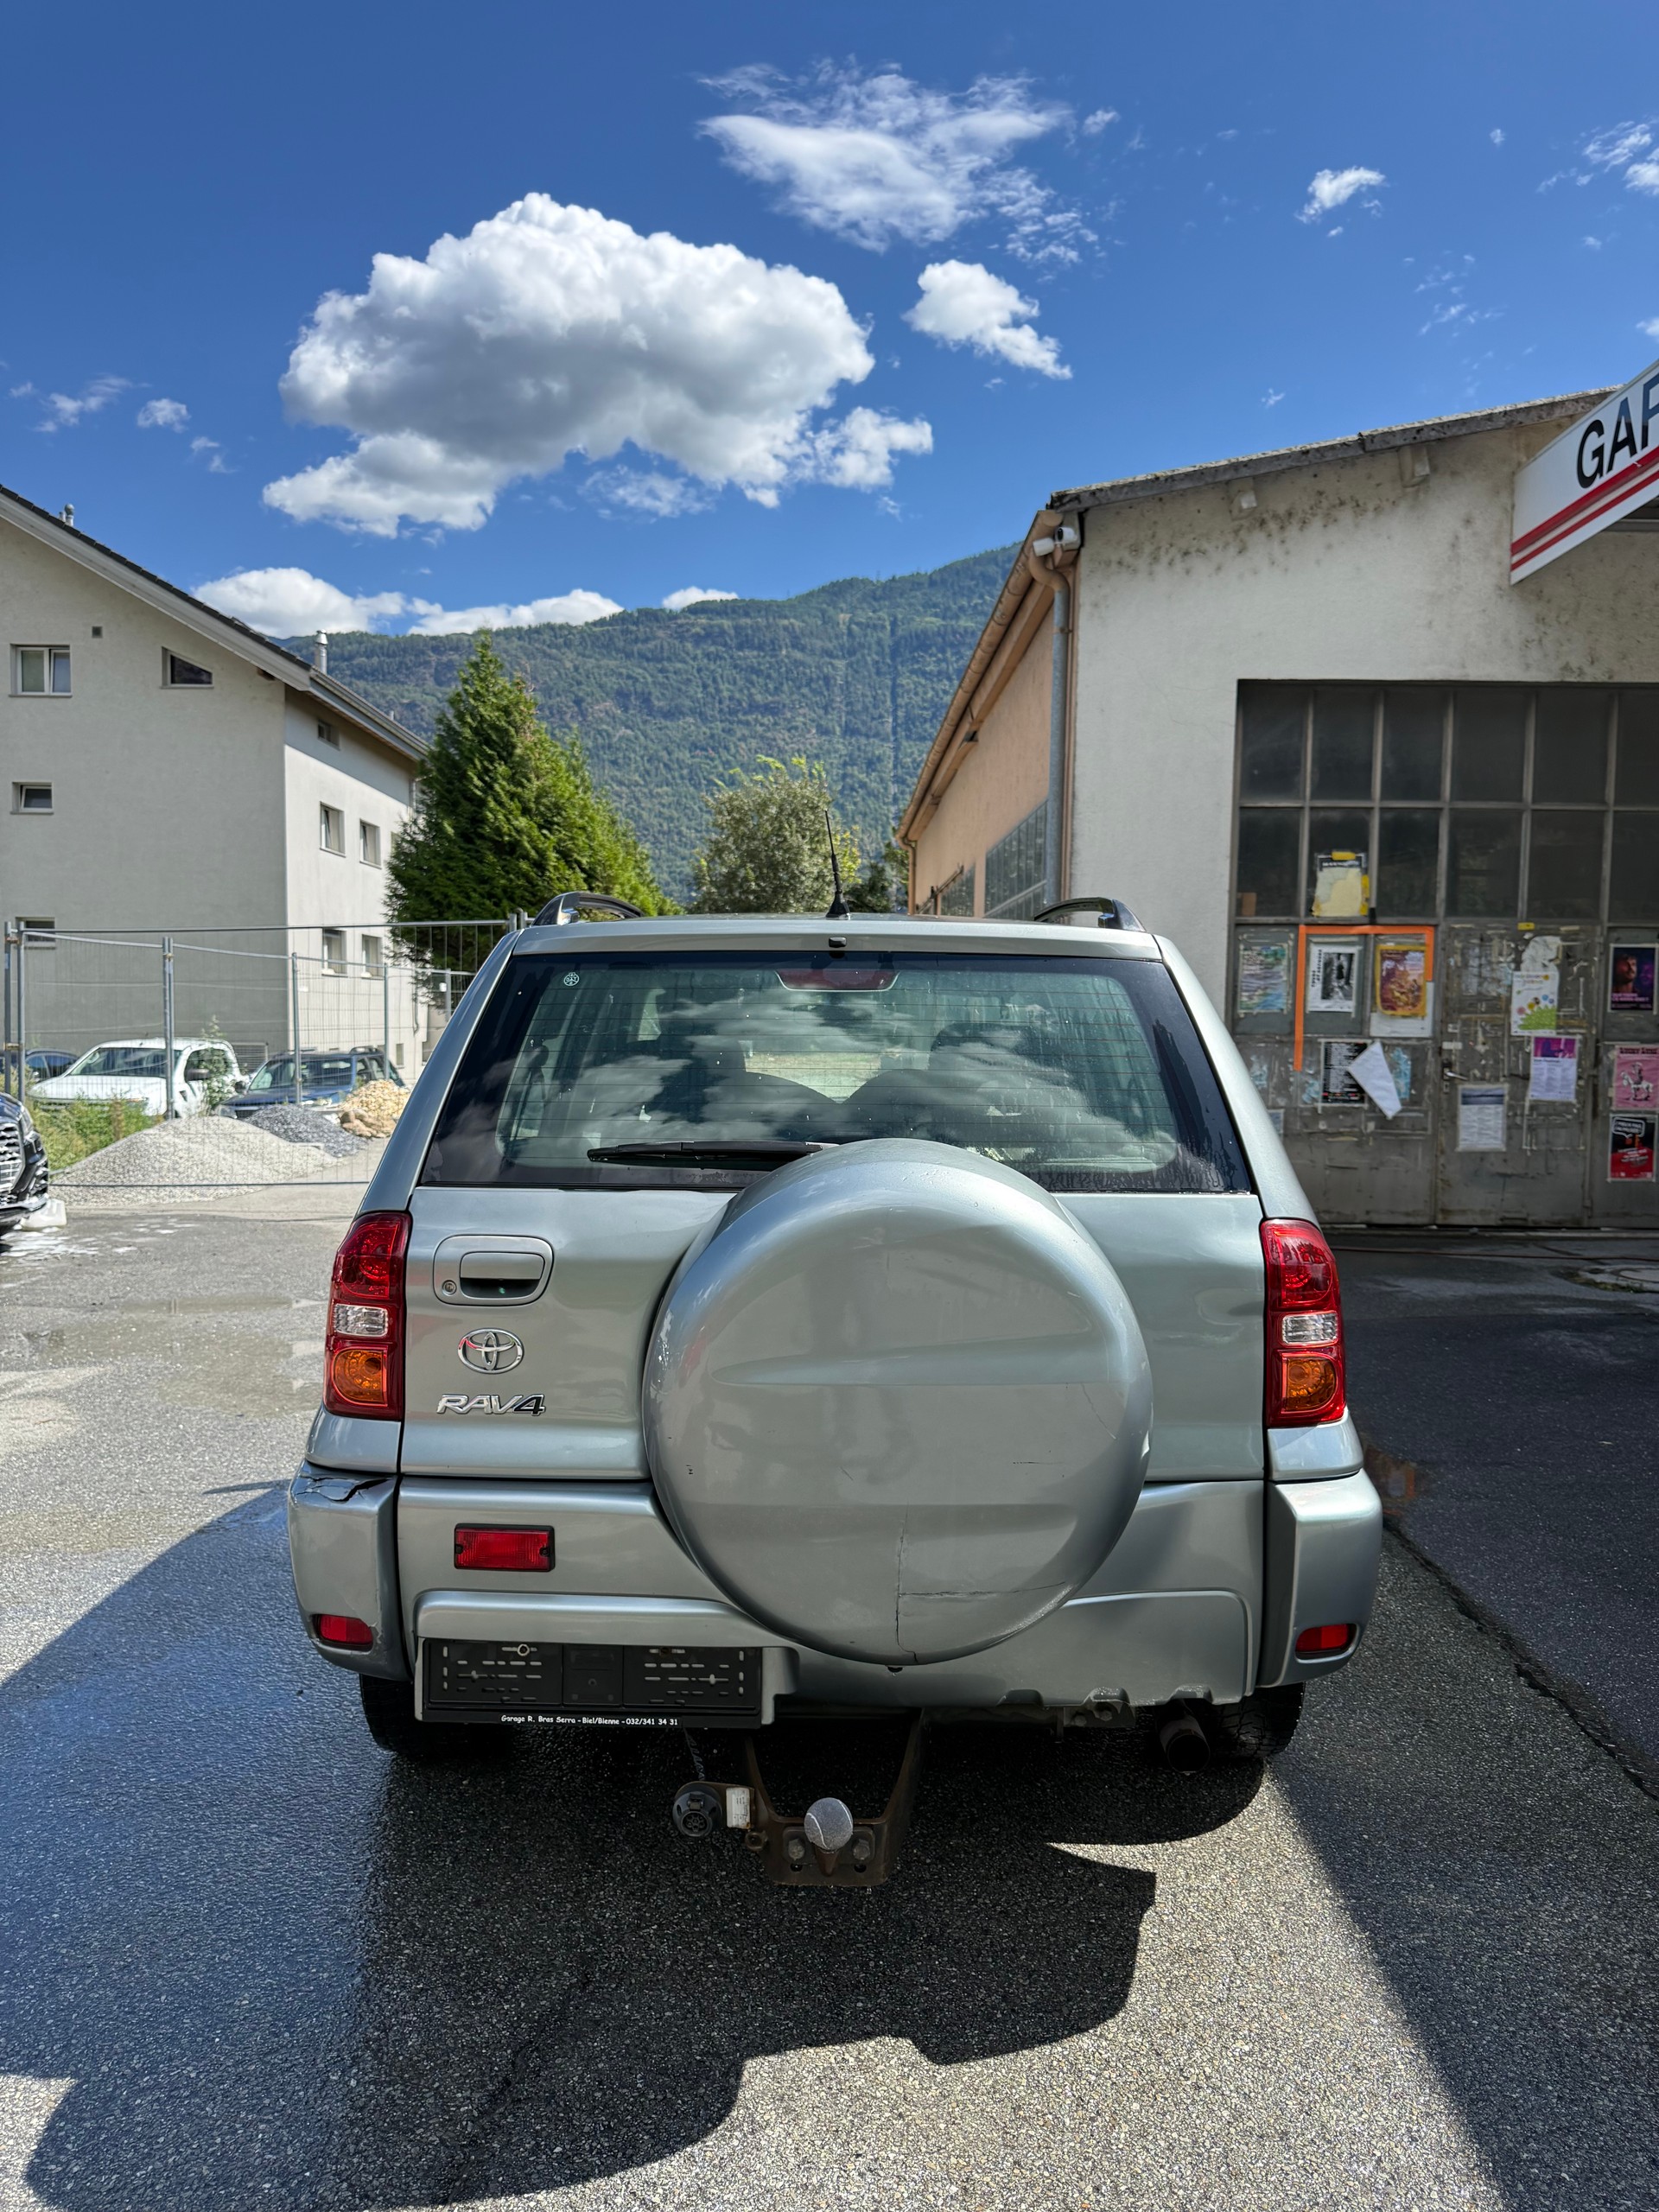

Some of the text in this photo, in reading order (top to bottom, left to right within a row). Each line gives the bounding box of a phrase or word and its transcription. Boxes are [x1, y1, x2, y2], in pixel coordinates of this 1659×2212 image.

[435, 1394, 546, 1416] RAV4
[500, 1714, 526, 1724] Garage
[527, 1714, 536, 1723] R.
